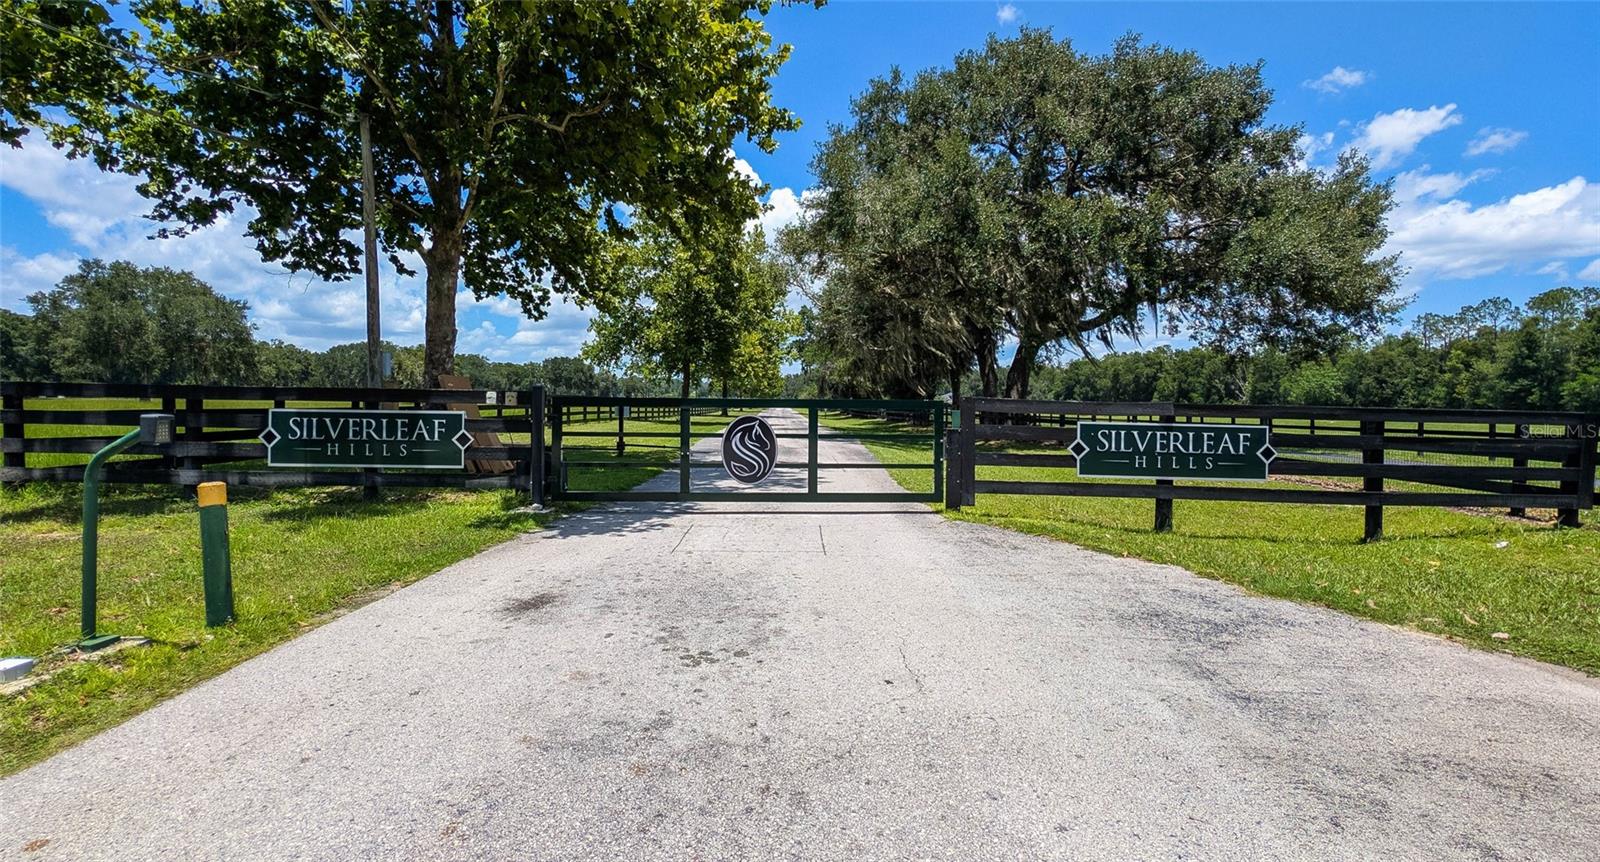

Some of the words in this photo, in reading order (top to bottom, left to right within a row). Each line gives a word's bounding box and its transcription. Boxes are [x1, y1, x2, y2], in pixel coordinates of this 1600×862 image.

[288, 417, 446, 441] SILVERLEAF
[326, 443, 408, 457] HILLS
[1096, 429, 1251, 455] SILVERLEAF
[1134, 455, 1213, 470] HILLS
